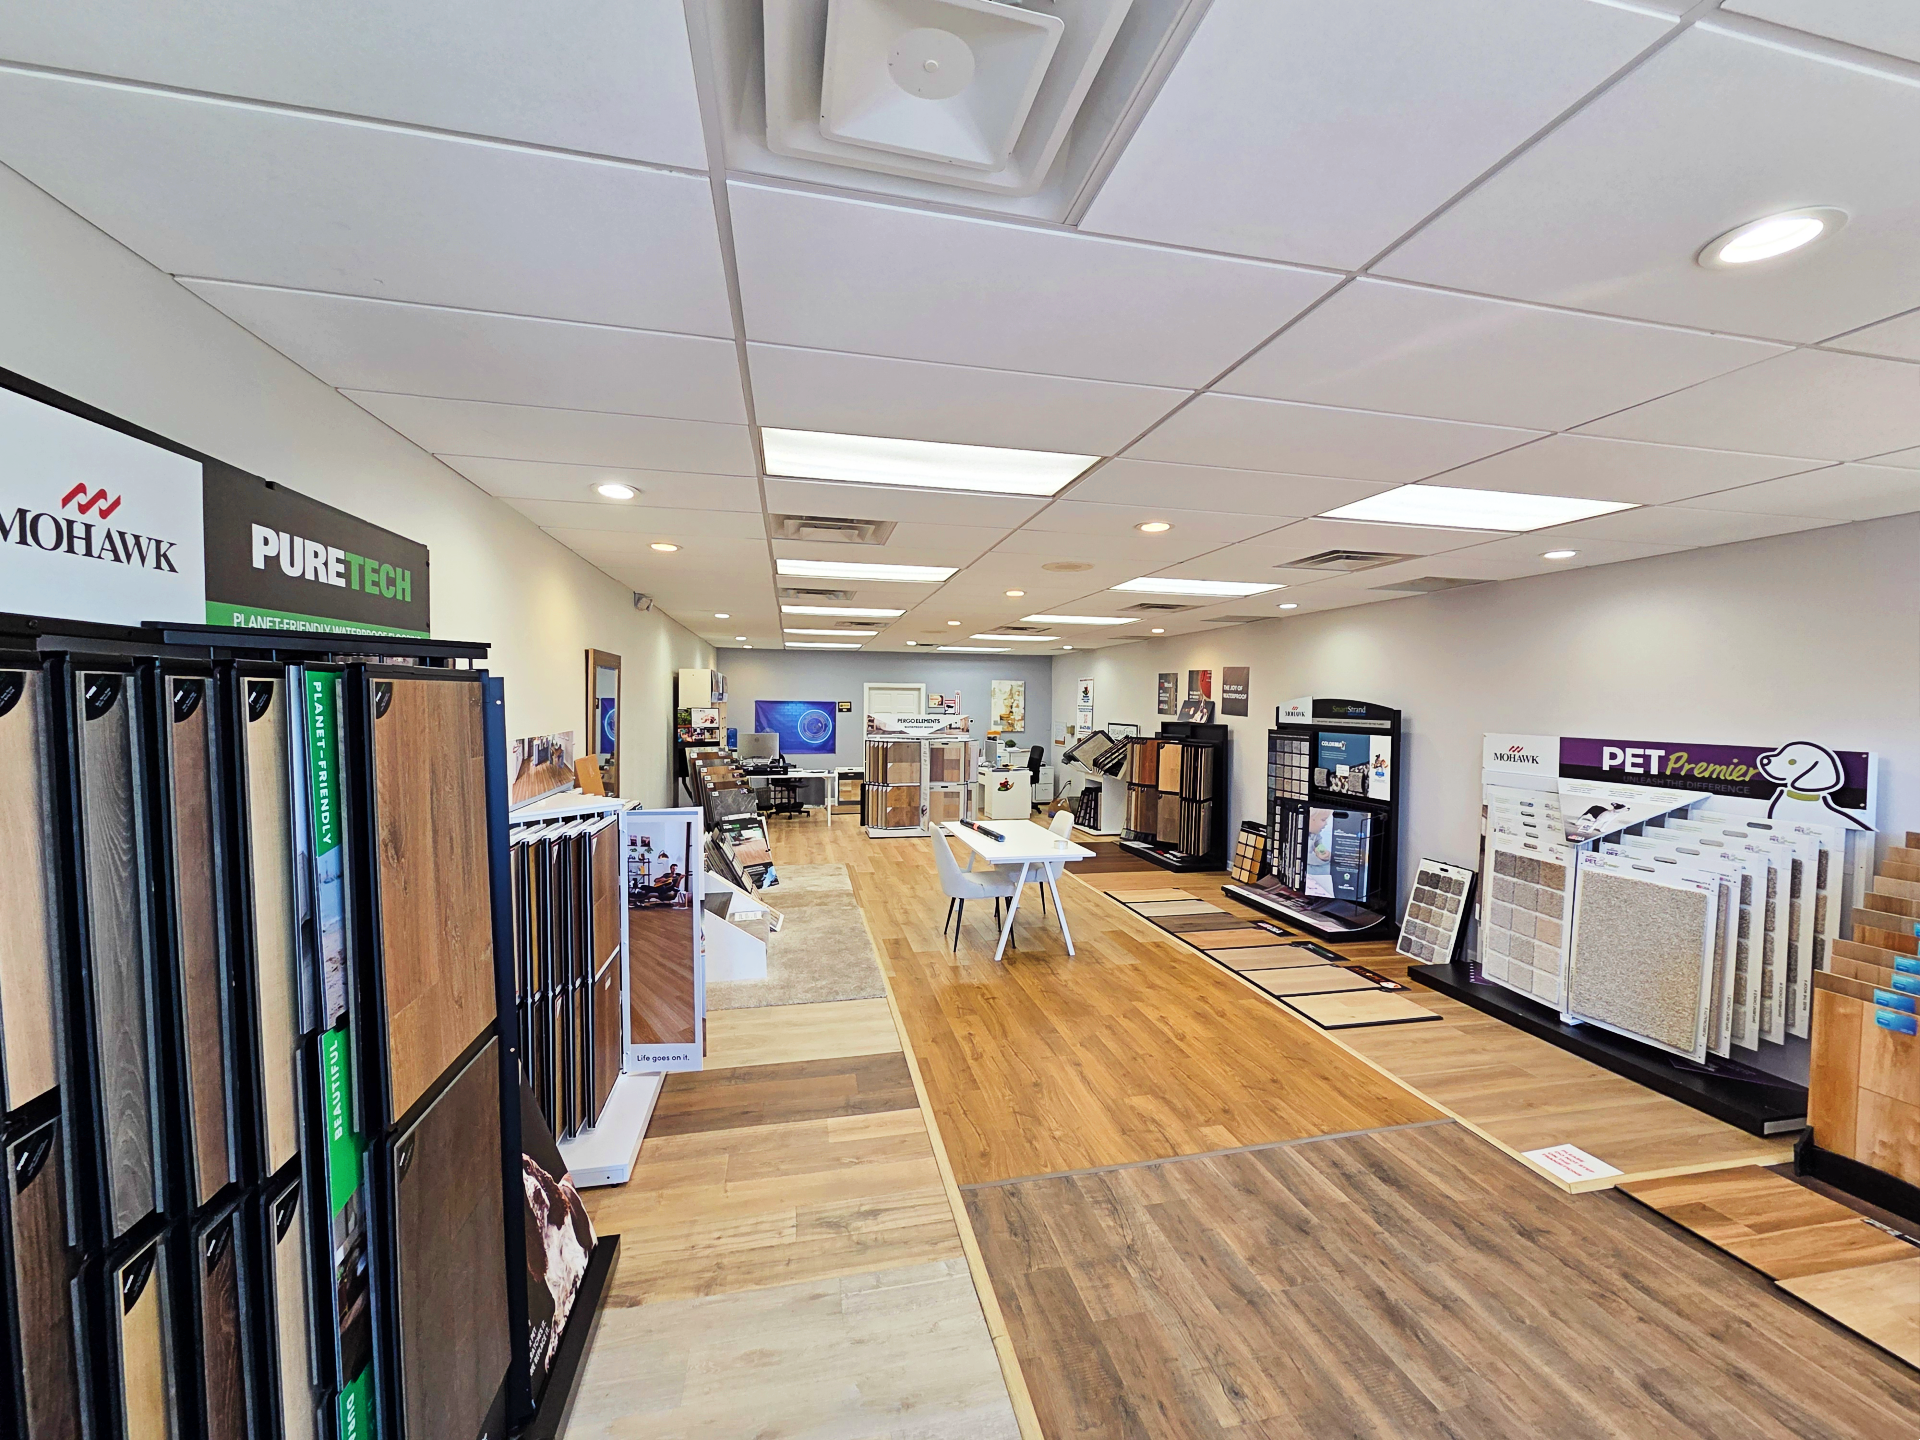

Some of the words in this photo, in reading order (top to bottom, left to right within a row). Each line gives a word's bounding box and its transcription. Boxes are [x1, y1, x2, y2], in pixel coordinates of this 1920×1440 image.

[0, 507, 179, 574] MOHAWK
[251, 522, 412, 602] PURETECH
[1332, 705, 1366, 714] SmartStrand
[313, 681, 332, 844] PLANET-FRIENDLY
[1493, 752, 1539, 765] MOHAWK
[1602, 746, 1666, 775] PET
[1665, 752, 1760, 781] Premier
[1623, 775, 1664, 787] UNLEASH
[1666, 779, 1684, 788] THE
[1686, 782, 1751, 795] DIFFERENCE
[329, 1040, 343, 1141] BEAUTIFUL
